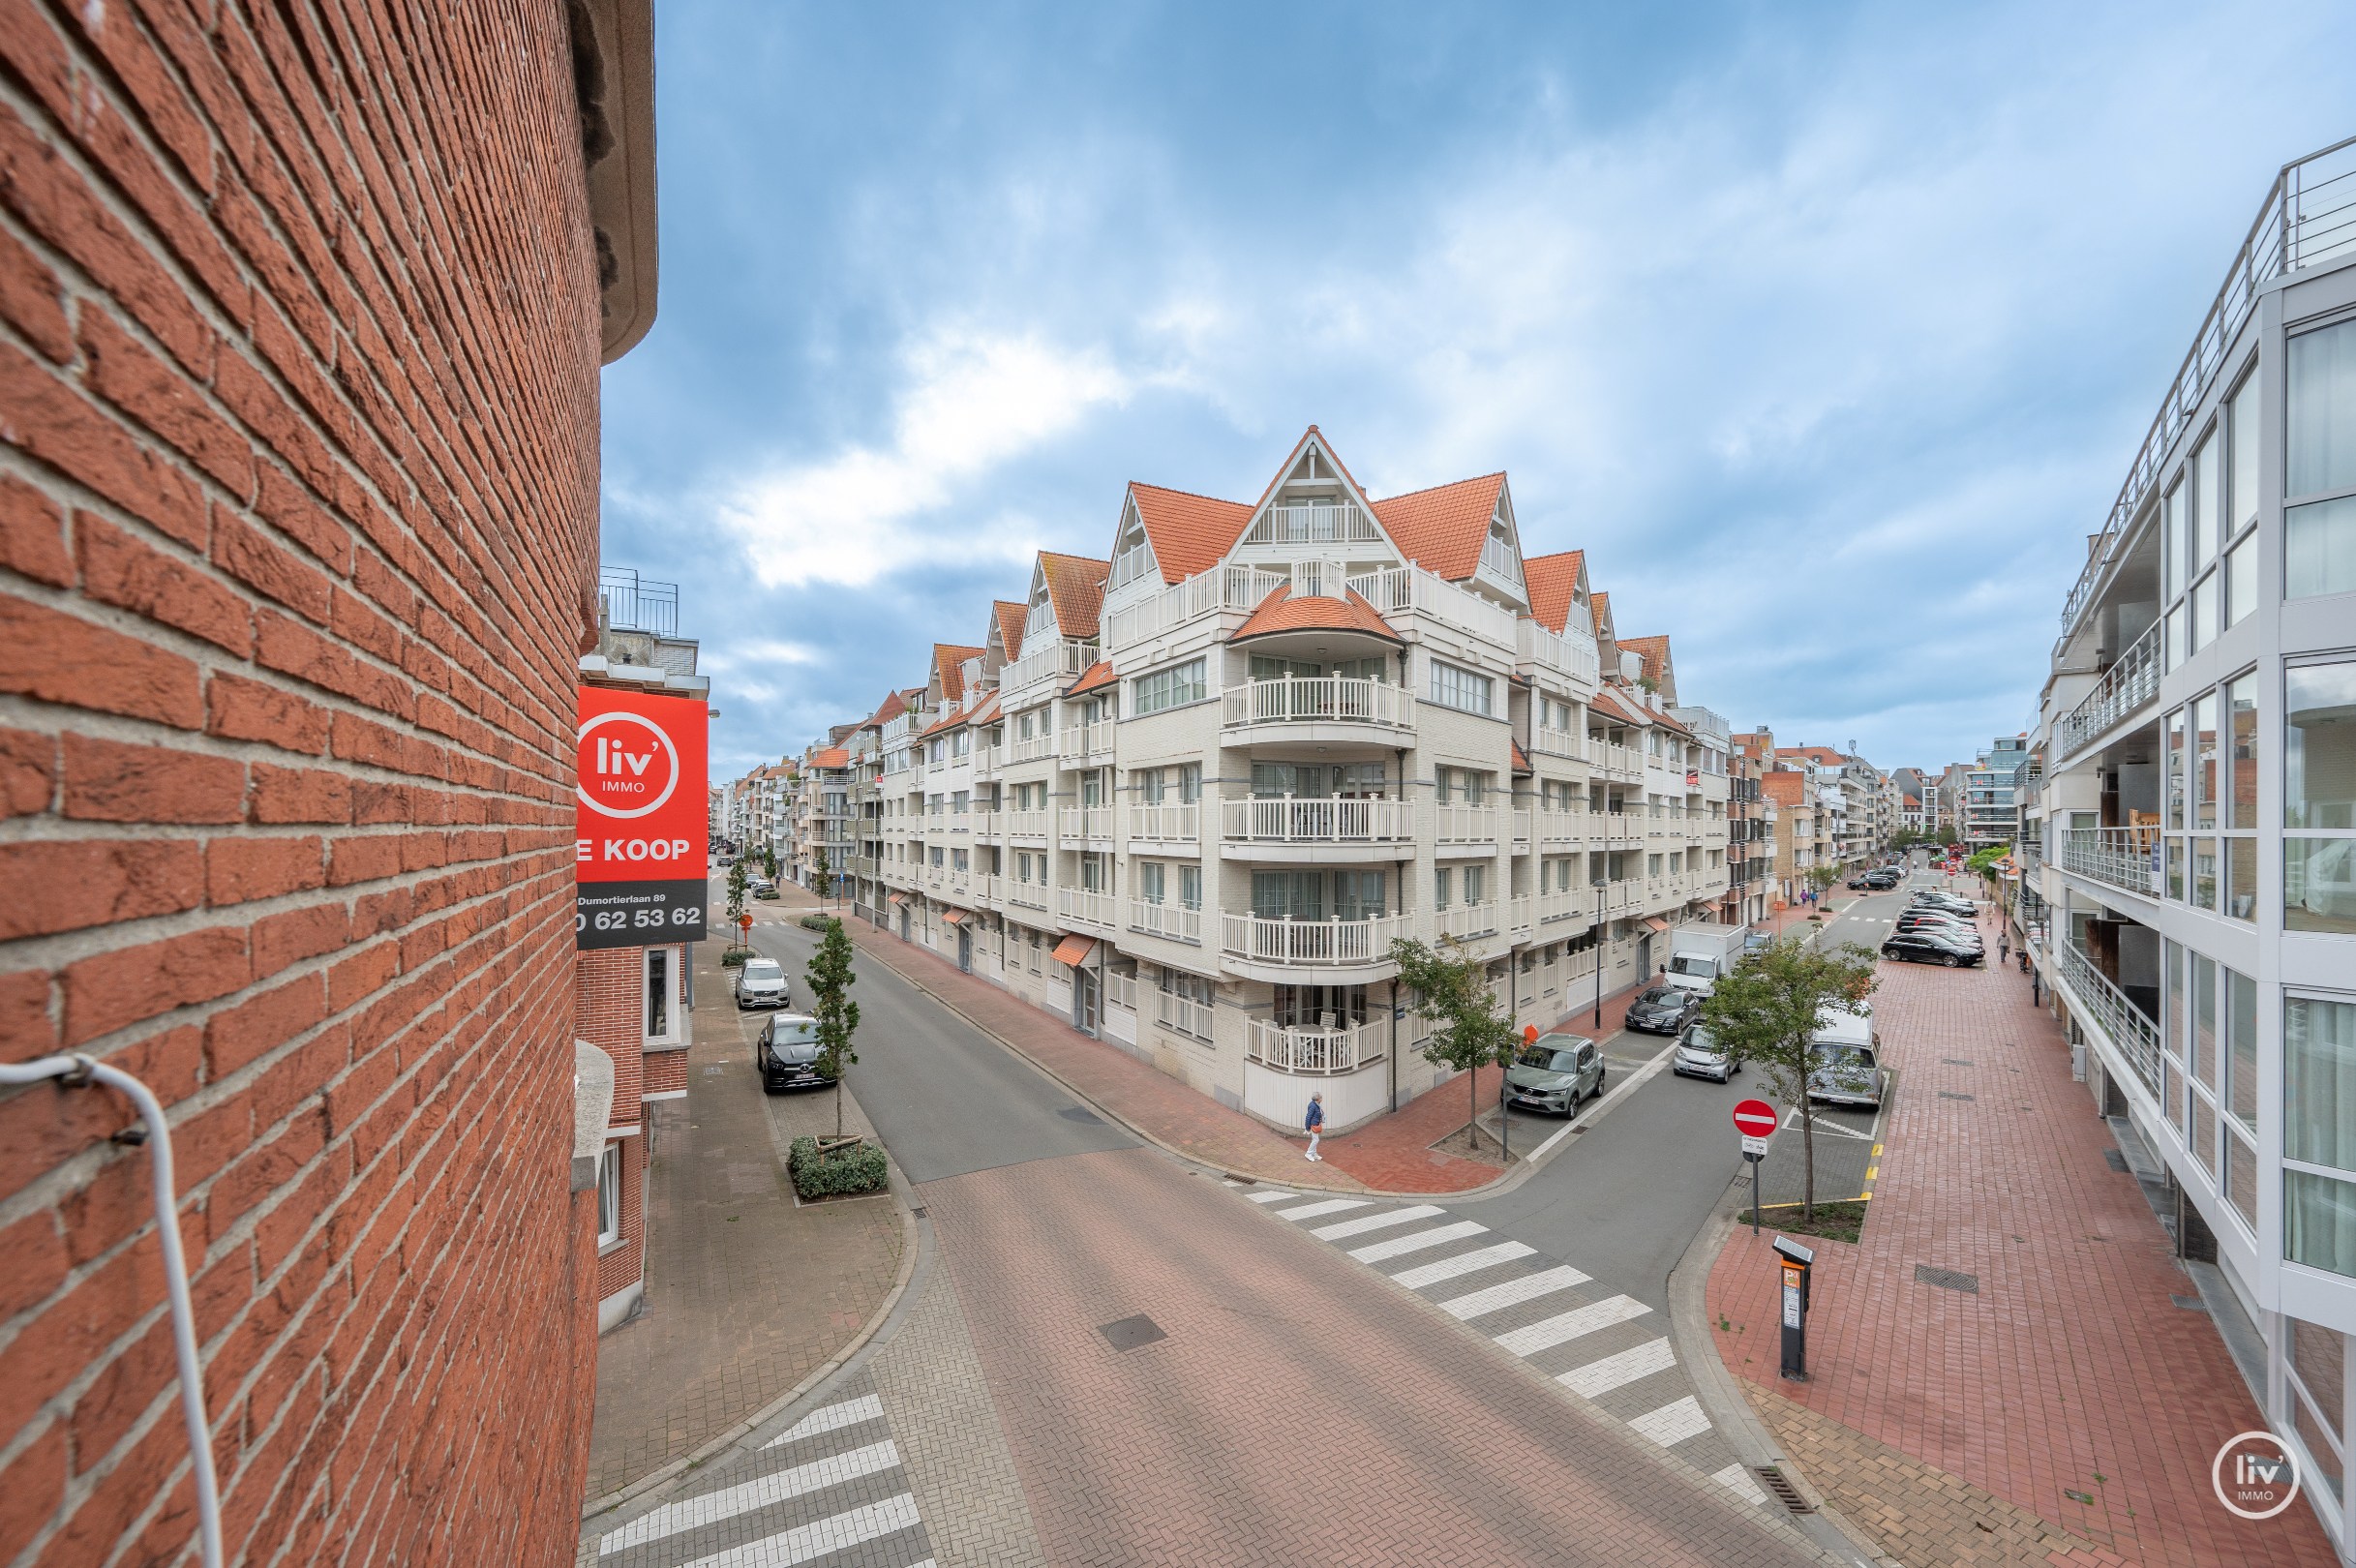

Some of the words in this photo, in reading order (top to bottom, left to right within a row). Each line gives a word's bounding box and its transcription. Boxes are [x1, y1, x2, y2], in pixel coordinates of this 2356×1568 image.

[597, 738, 659, 776] liv'
[602, 781, 646, 793] IMMO
[576, 839, 592, 861] E
[604, 838, 690, 861] KOOP
[578, 895, 650, 906] Dumortierlaan
[594, 911, 627, 930] 62
[634, 909, 665, 927] 53
[672, 907, 701, 925] 62
